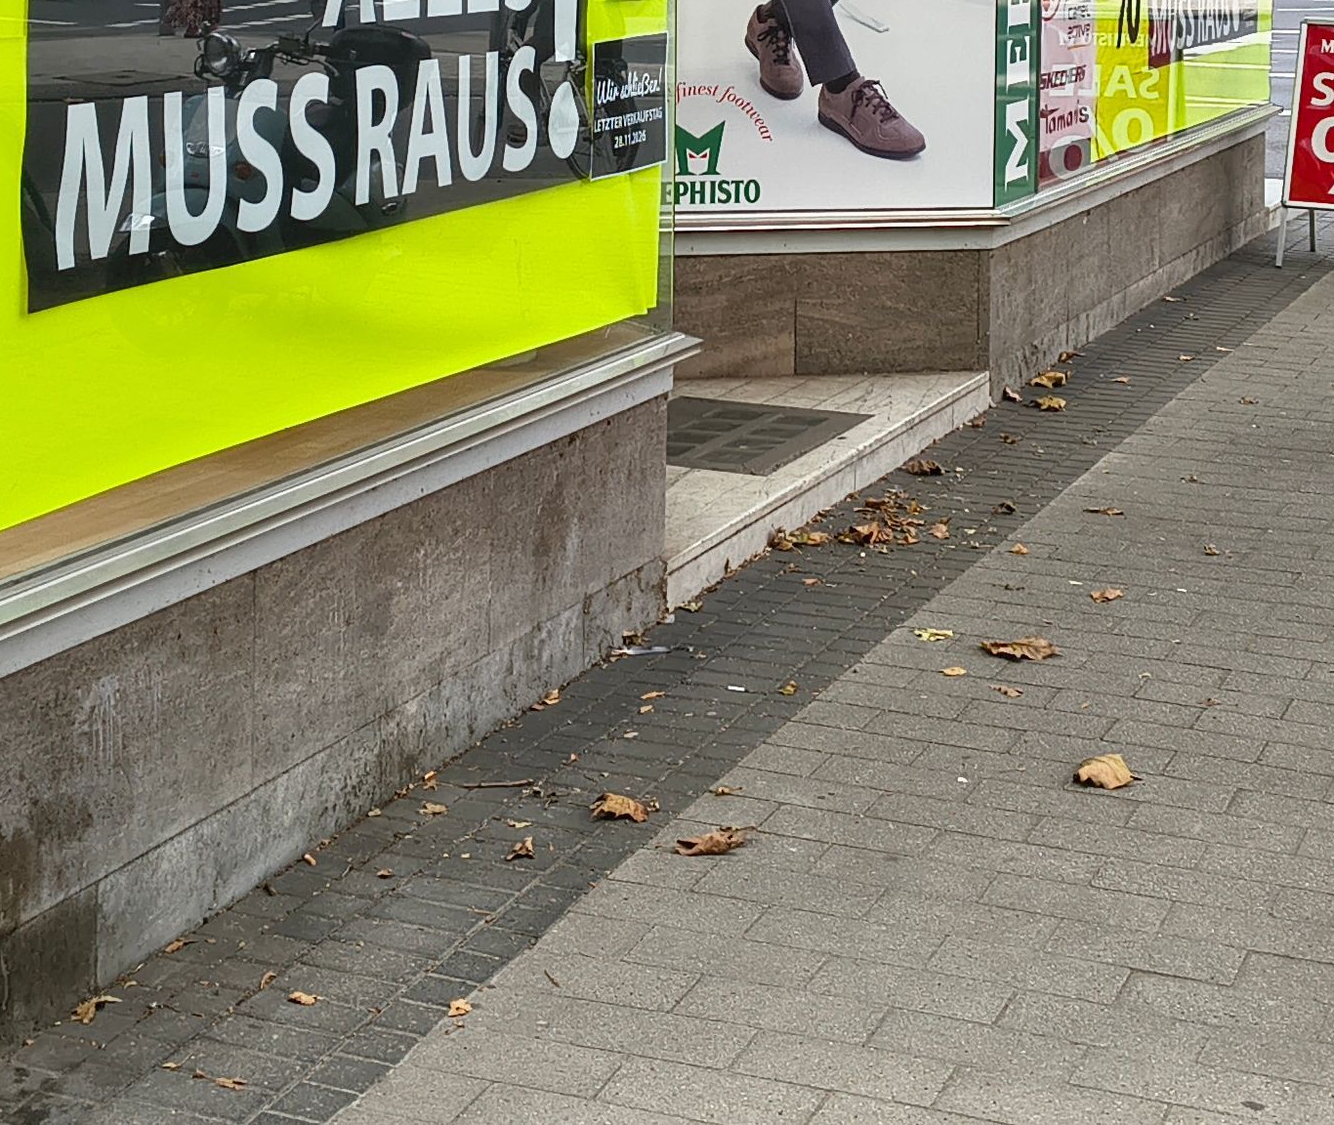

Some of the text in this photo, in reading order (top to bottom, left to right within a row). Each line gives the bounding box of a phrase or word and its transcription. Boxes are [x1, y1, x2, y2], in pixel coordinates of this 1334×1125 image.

[55, 71, 336, 271] MUSS
[675, 82, 774, 143] finest footwear
